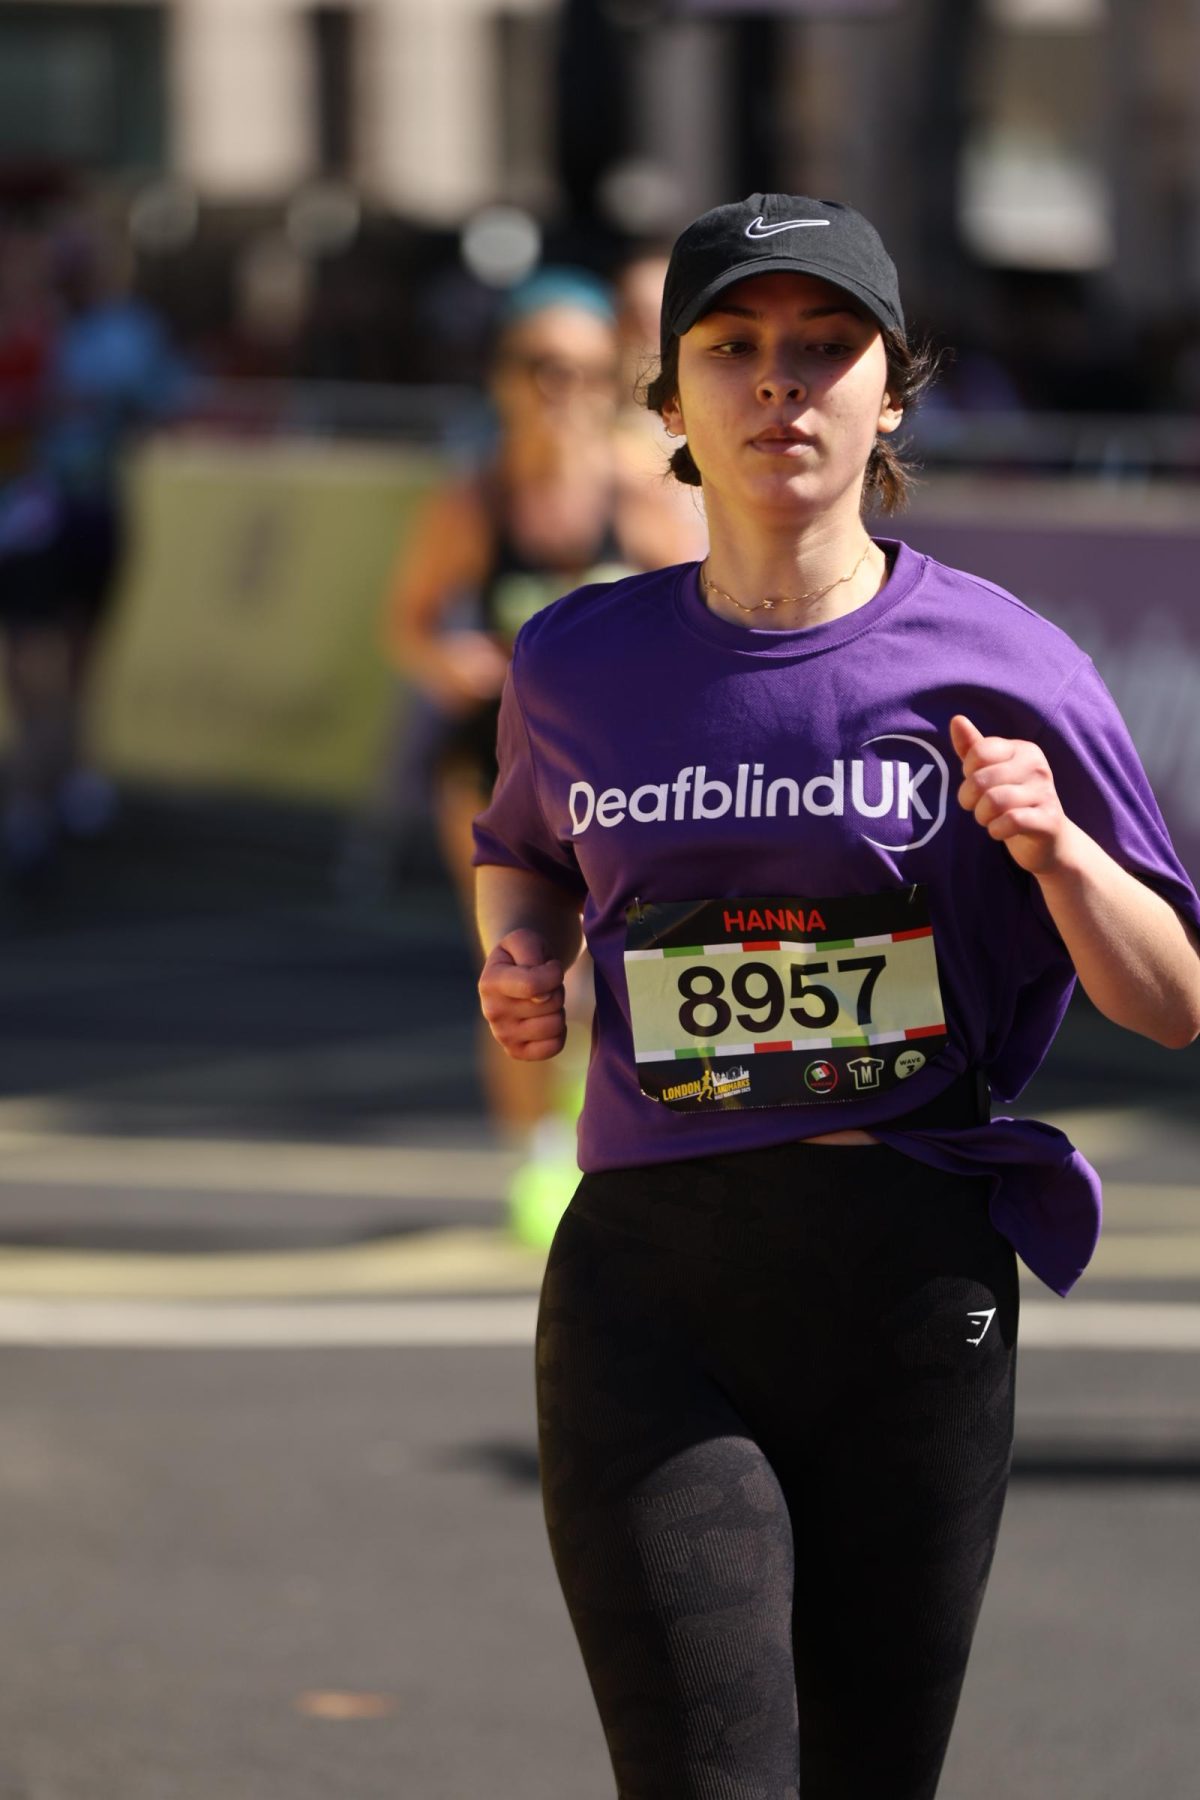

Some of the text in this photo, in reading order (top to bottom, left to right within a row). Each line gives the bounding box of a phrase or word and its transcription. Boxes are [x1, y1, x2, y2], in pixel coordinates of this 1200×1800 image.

[723, 909, 827, 933] HANNA
[677, 955, 887, 1038] 8957
[899, 1057, 921, 1066] WAVE
[861, 1065, 873, 1084] M
[662, 1080, 701, 1101] LONDON
